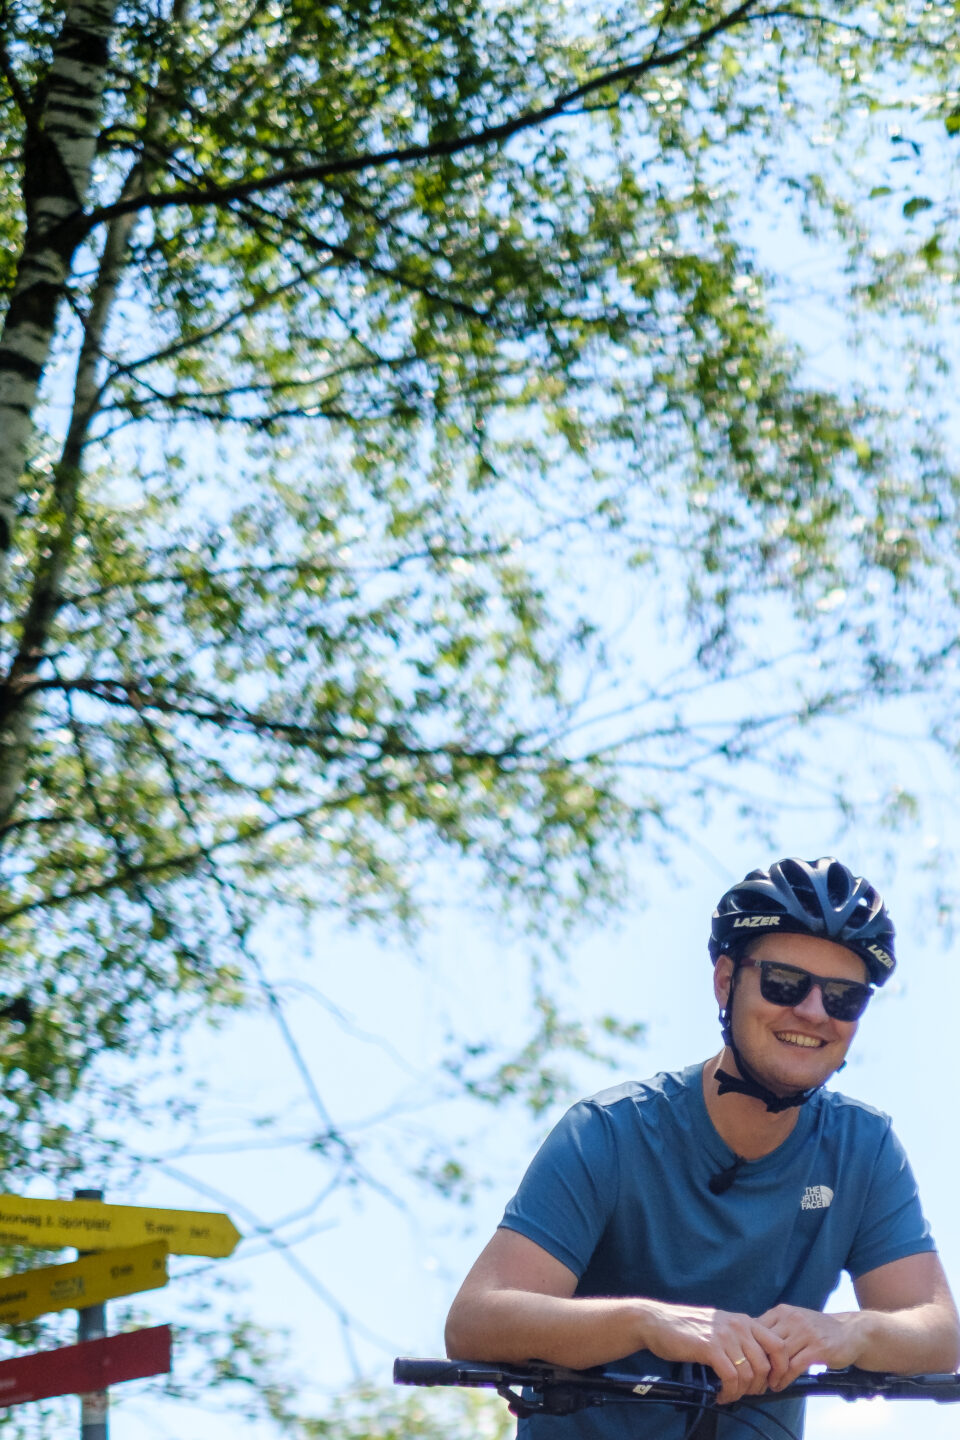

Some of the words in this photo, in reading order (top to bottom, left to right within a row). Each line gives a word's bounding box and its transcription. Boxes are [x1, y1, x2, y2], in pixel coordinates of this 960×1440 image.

[733, 915, 781, 928] LAZER
[806, 1186, 820, 1195] THE
[801, 1201, 823, 1210] FACE
[0, 1212, 42, 1228] oorweg
